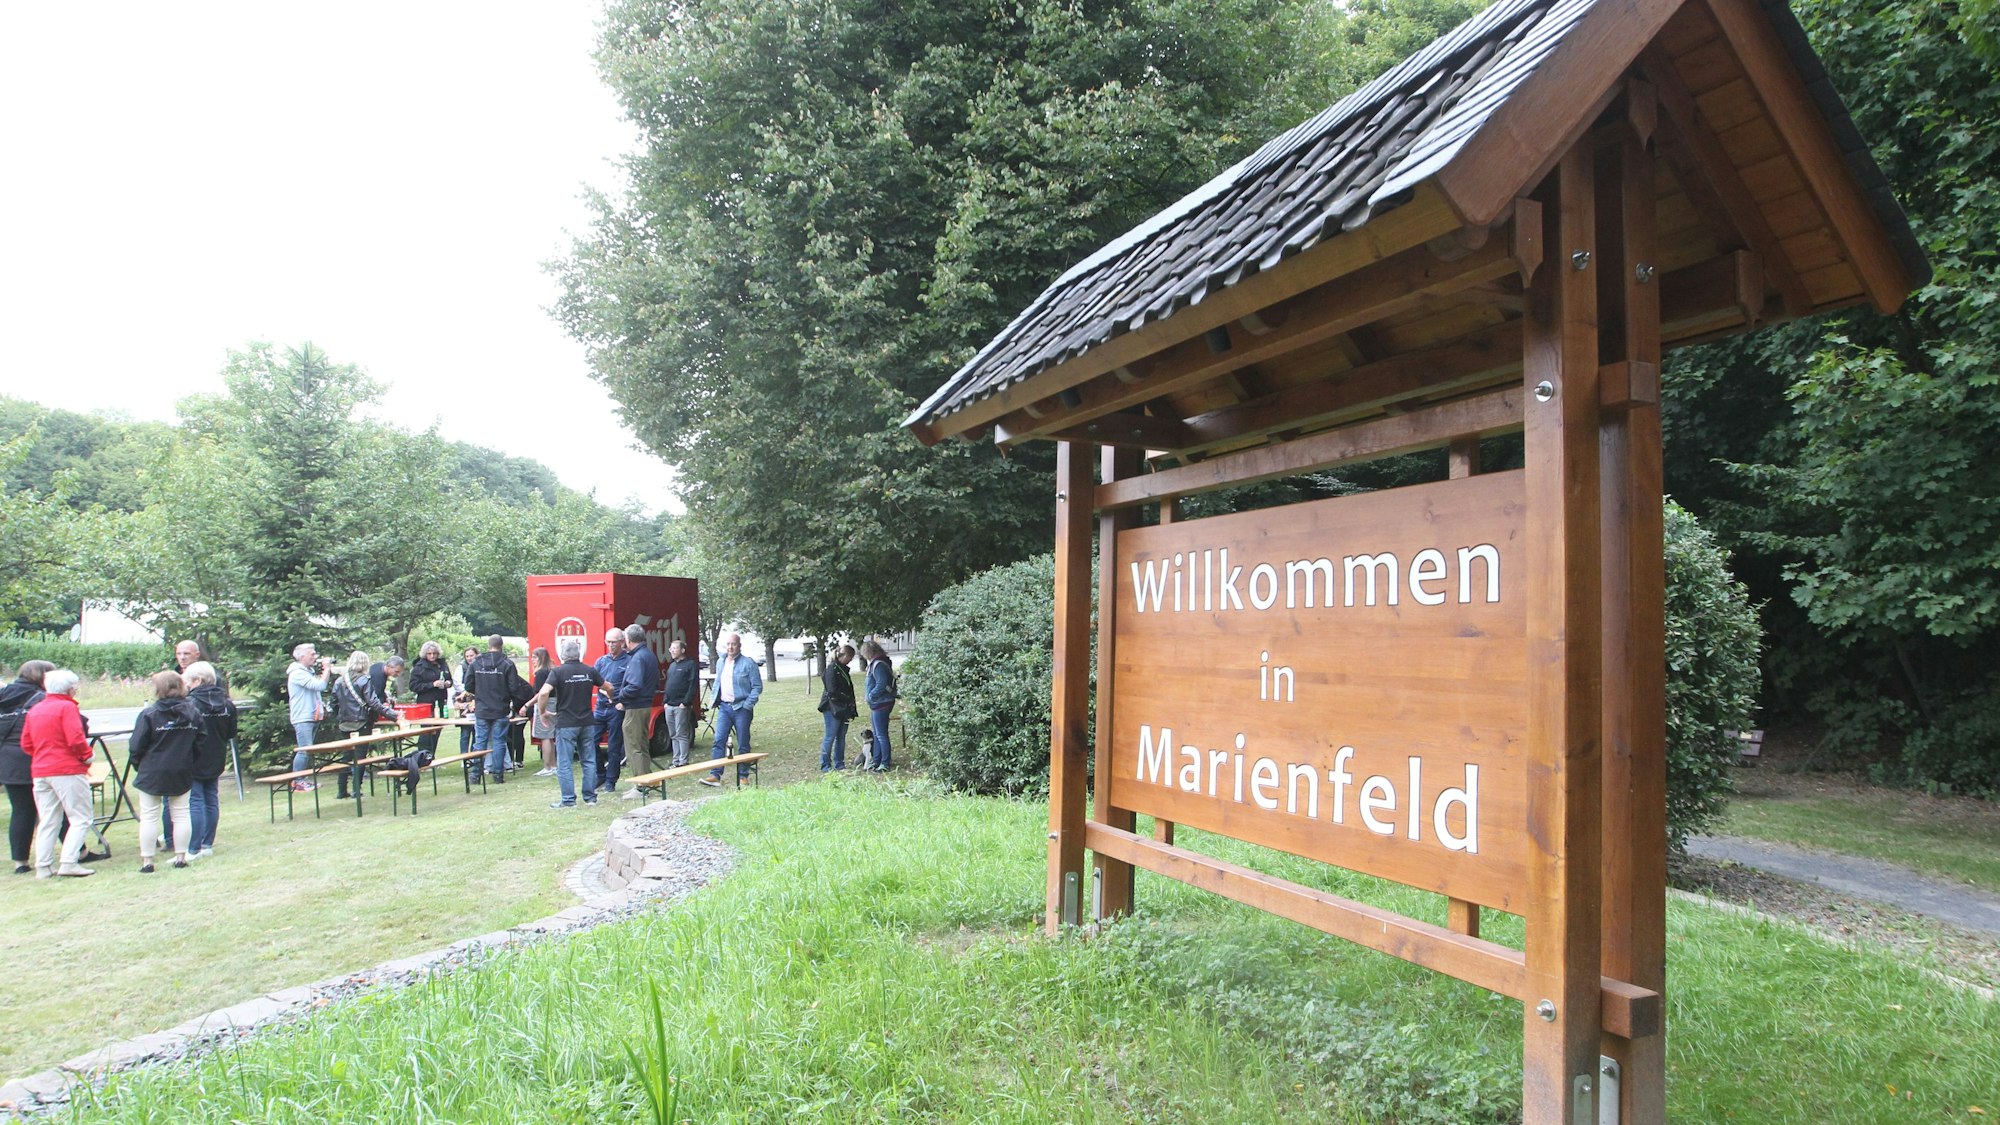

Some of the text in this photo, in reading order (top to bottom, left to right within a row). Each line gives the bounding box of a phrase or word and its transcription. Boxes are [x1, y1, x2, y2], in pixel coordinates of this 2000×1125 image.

[1130, 541, 1502, 614] Willkommen
[1258, 650, 1297, 704] in
[1136, 723, 1481, 856] Marienfeld
